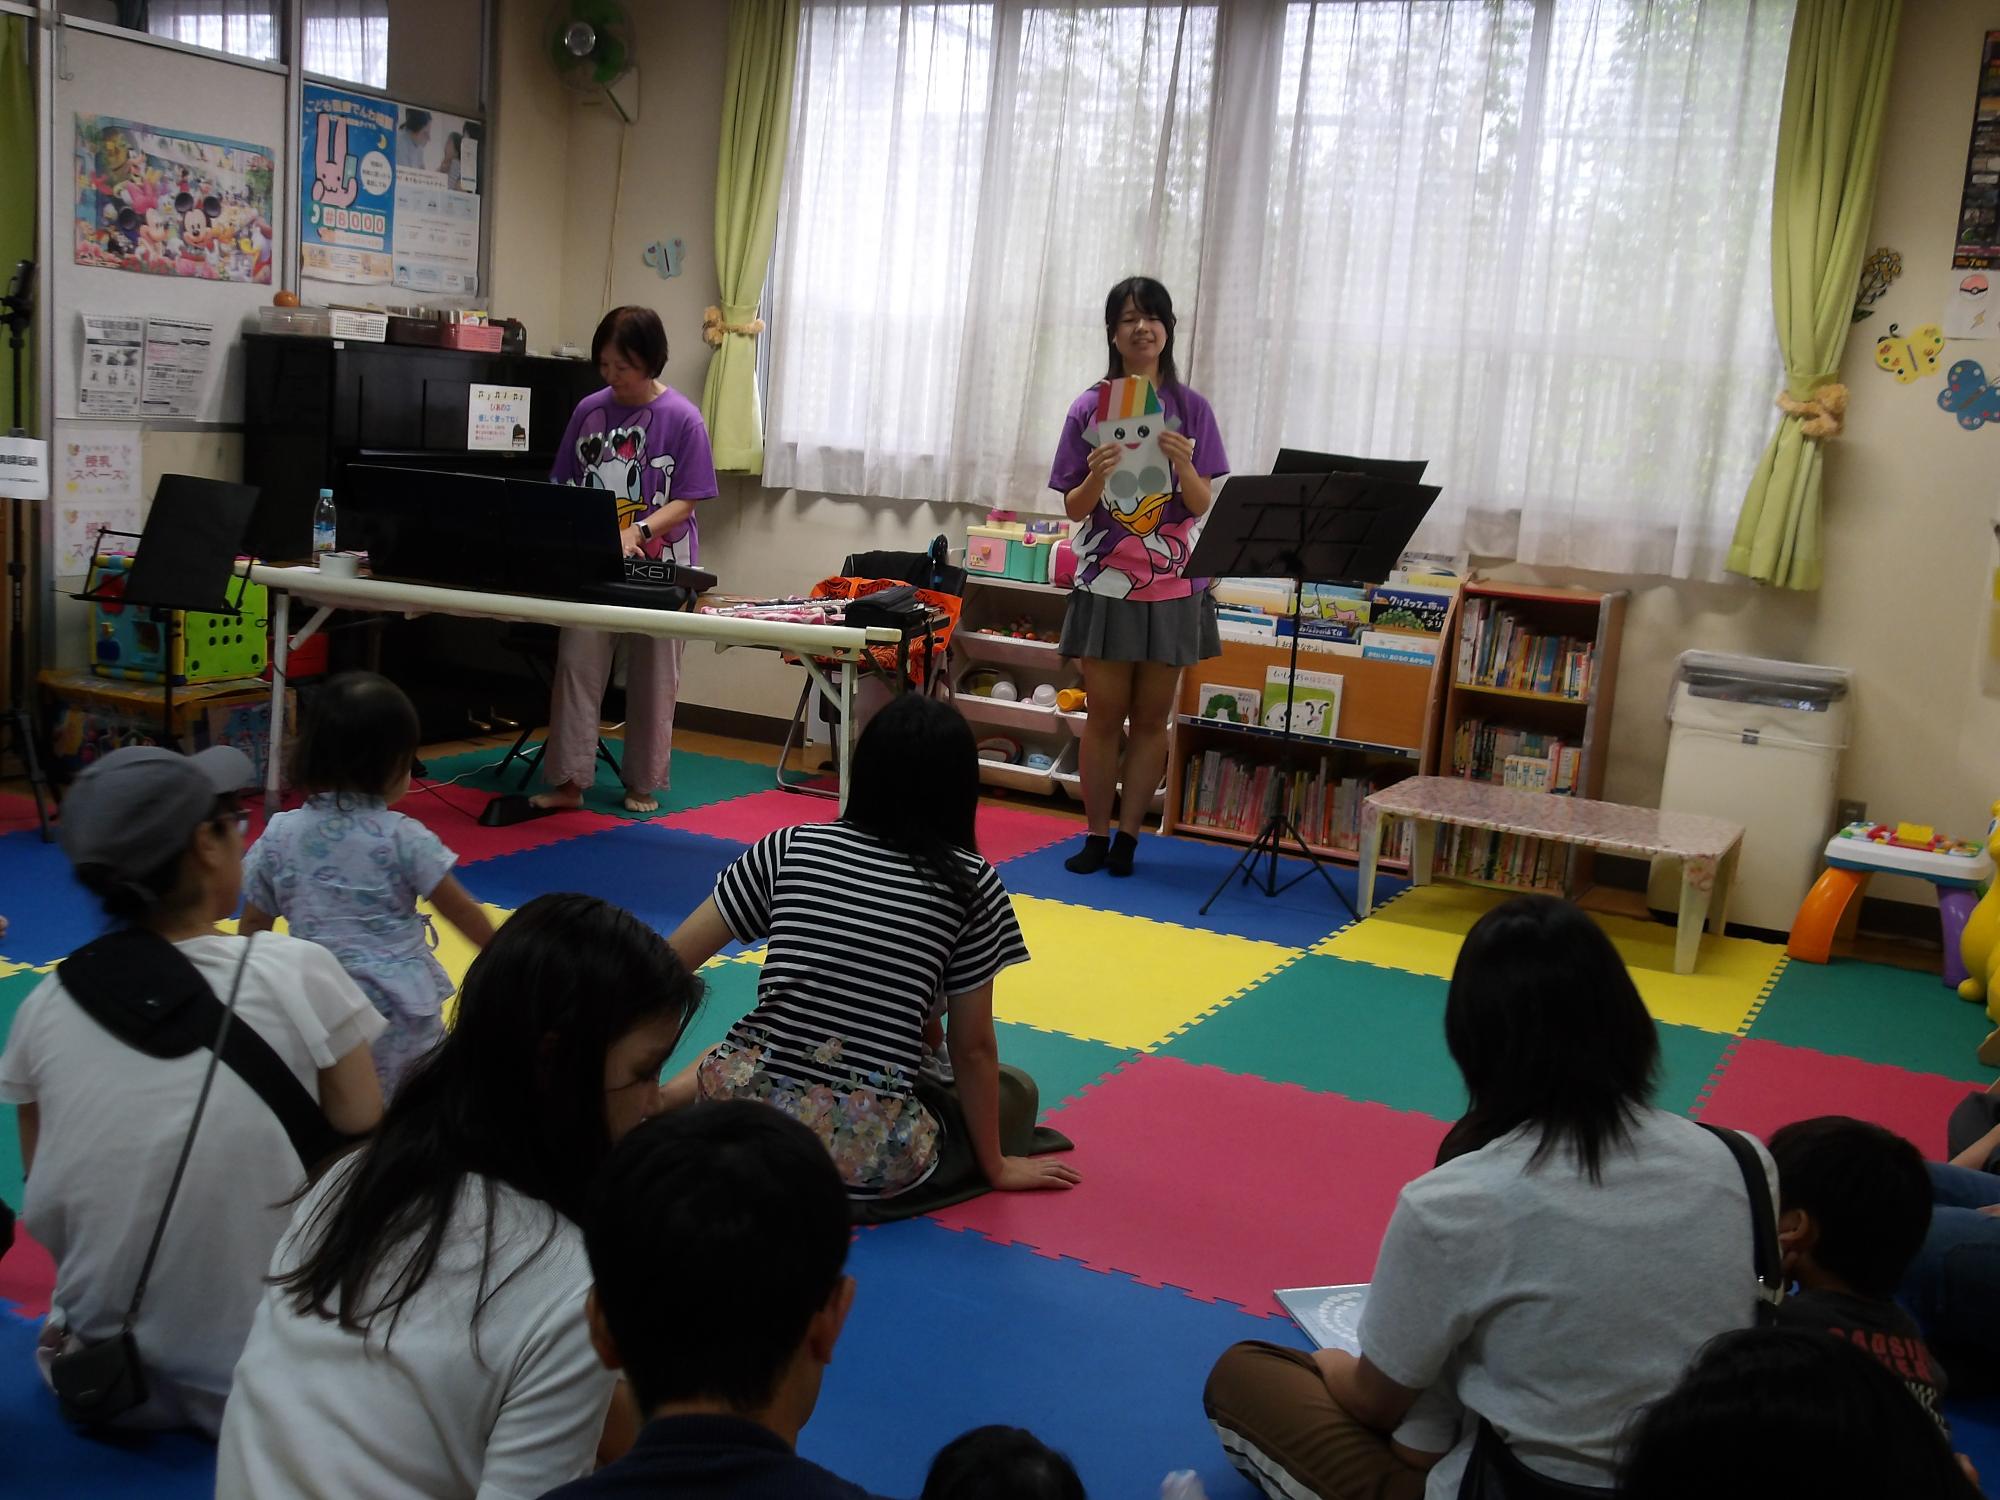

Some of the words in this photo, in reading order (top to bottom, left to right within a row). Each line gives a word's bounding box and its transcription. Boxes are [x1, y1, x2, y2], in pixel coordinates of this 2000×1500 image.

[325, 210, 384, 232] #8000
[70, 469, 123, 481] スペース
